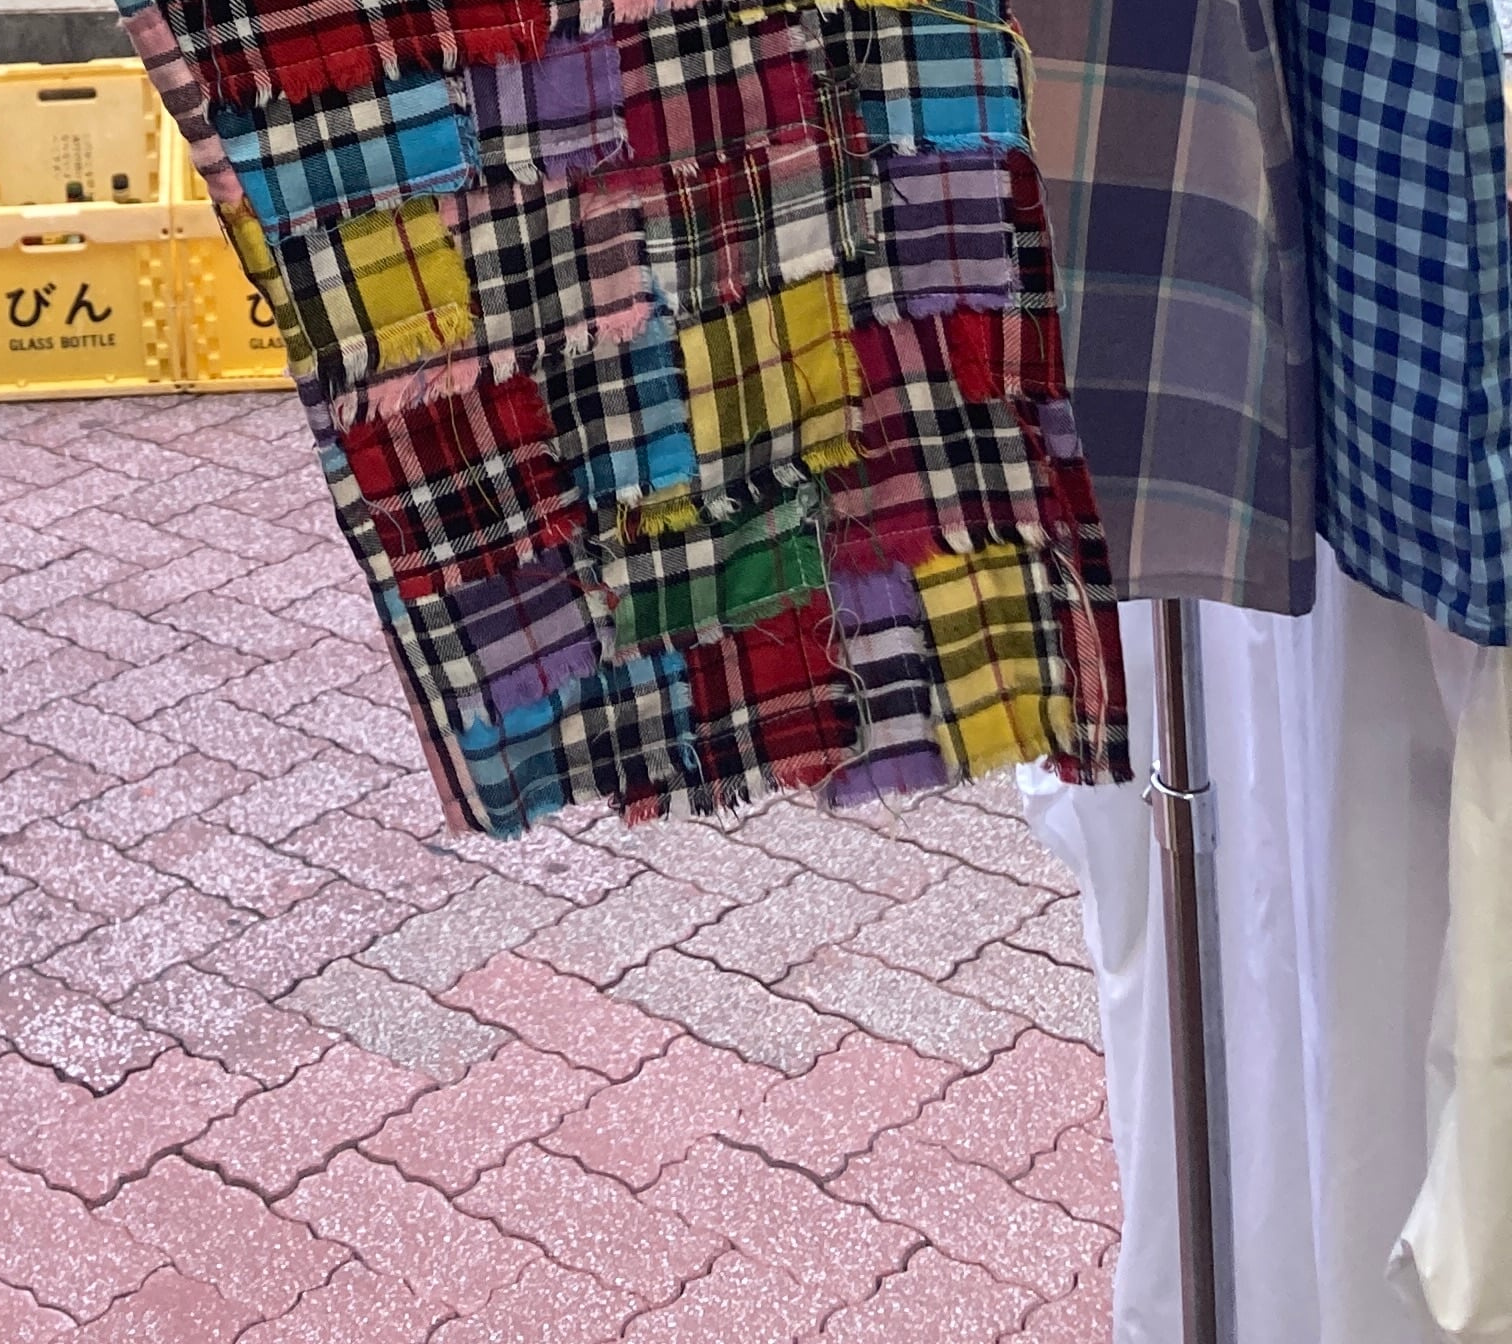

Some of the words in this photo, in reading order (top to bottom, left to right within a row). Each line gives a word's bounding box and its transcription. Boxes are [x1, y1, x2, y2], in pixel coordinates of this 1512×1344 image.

[5, 282, 112, 328] びん
[8, 334, 54, 352] GLASS
[60, 332, 117, 349] BOTTLE
